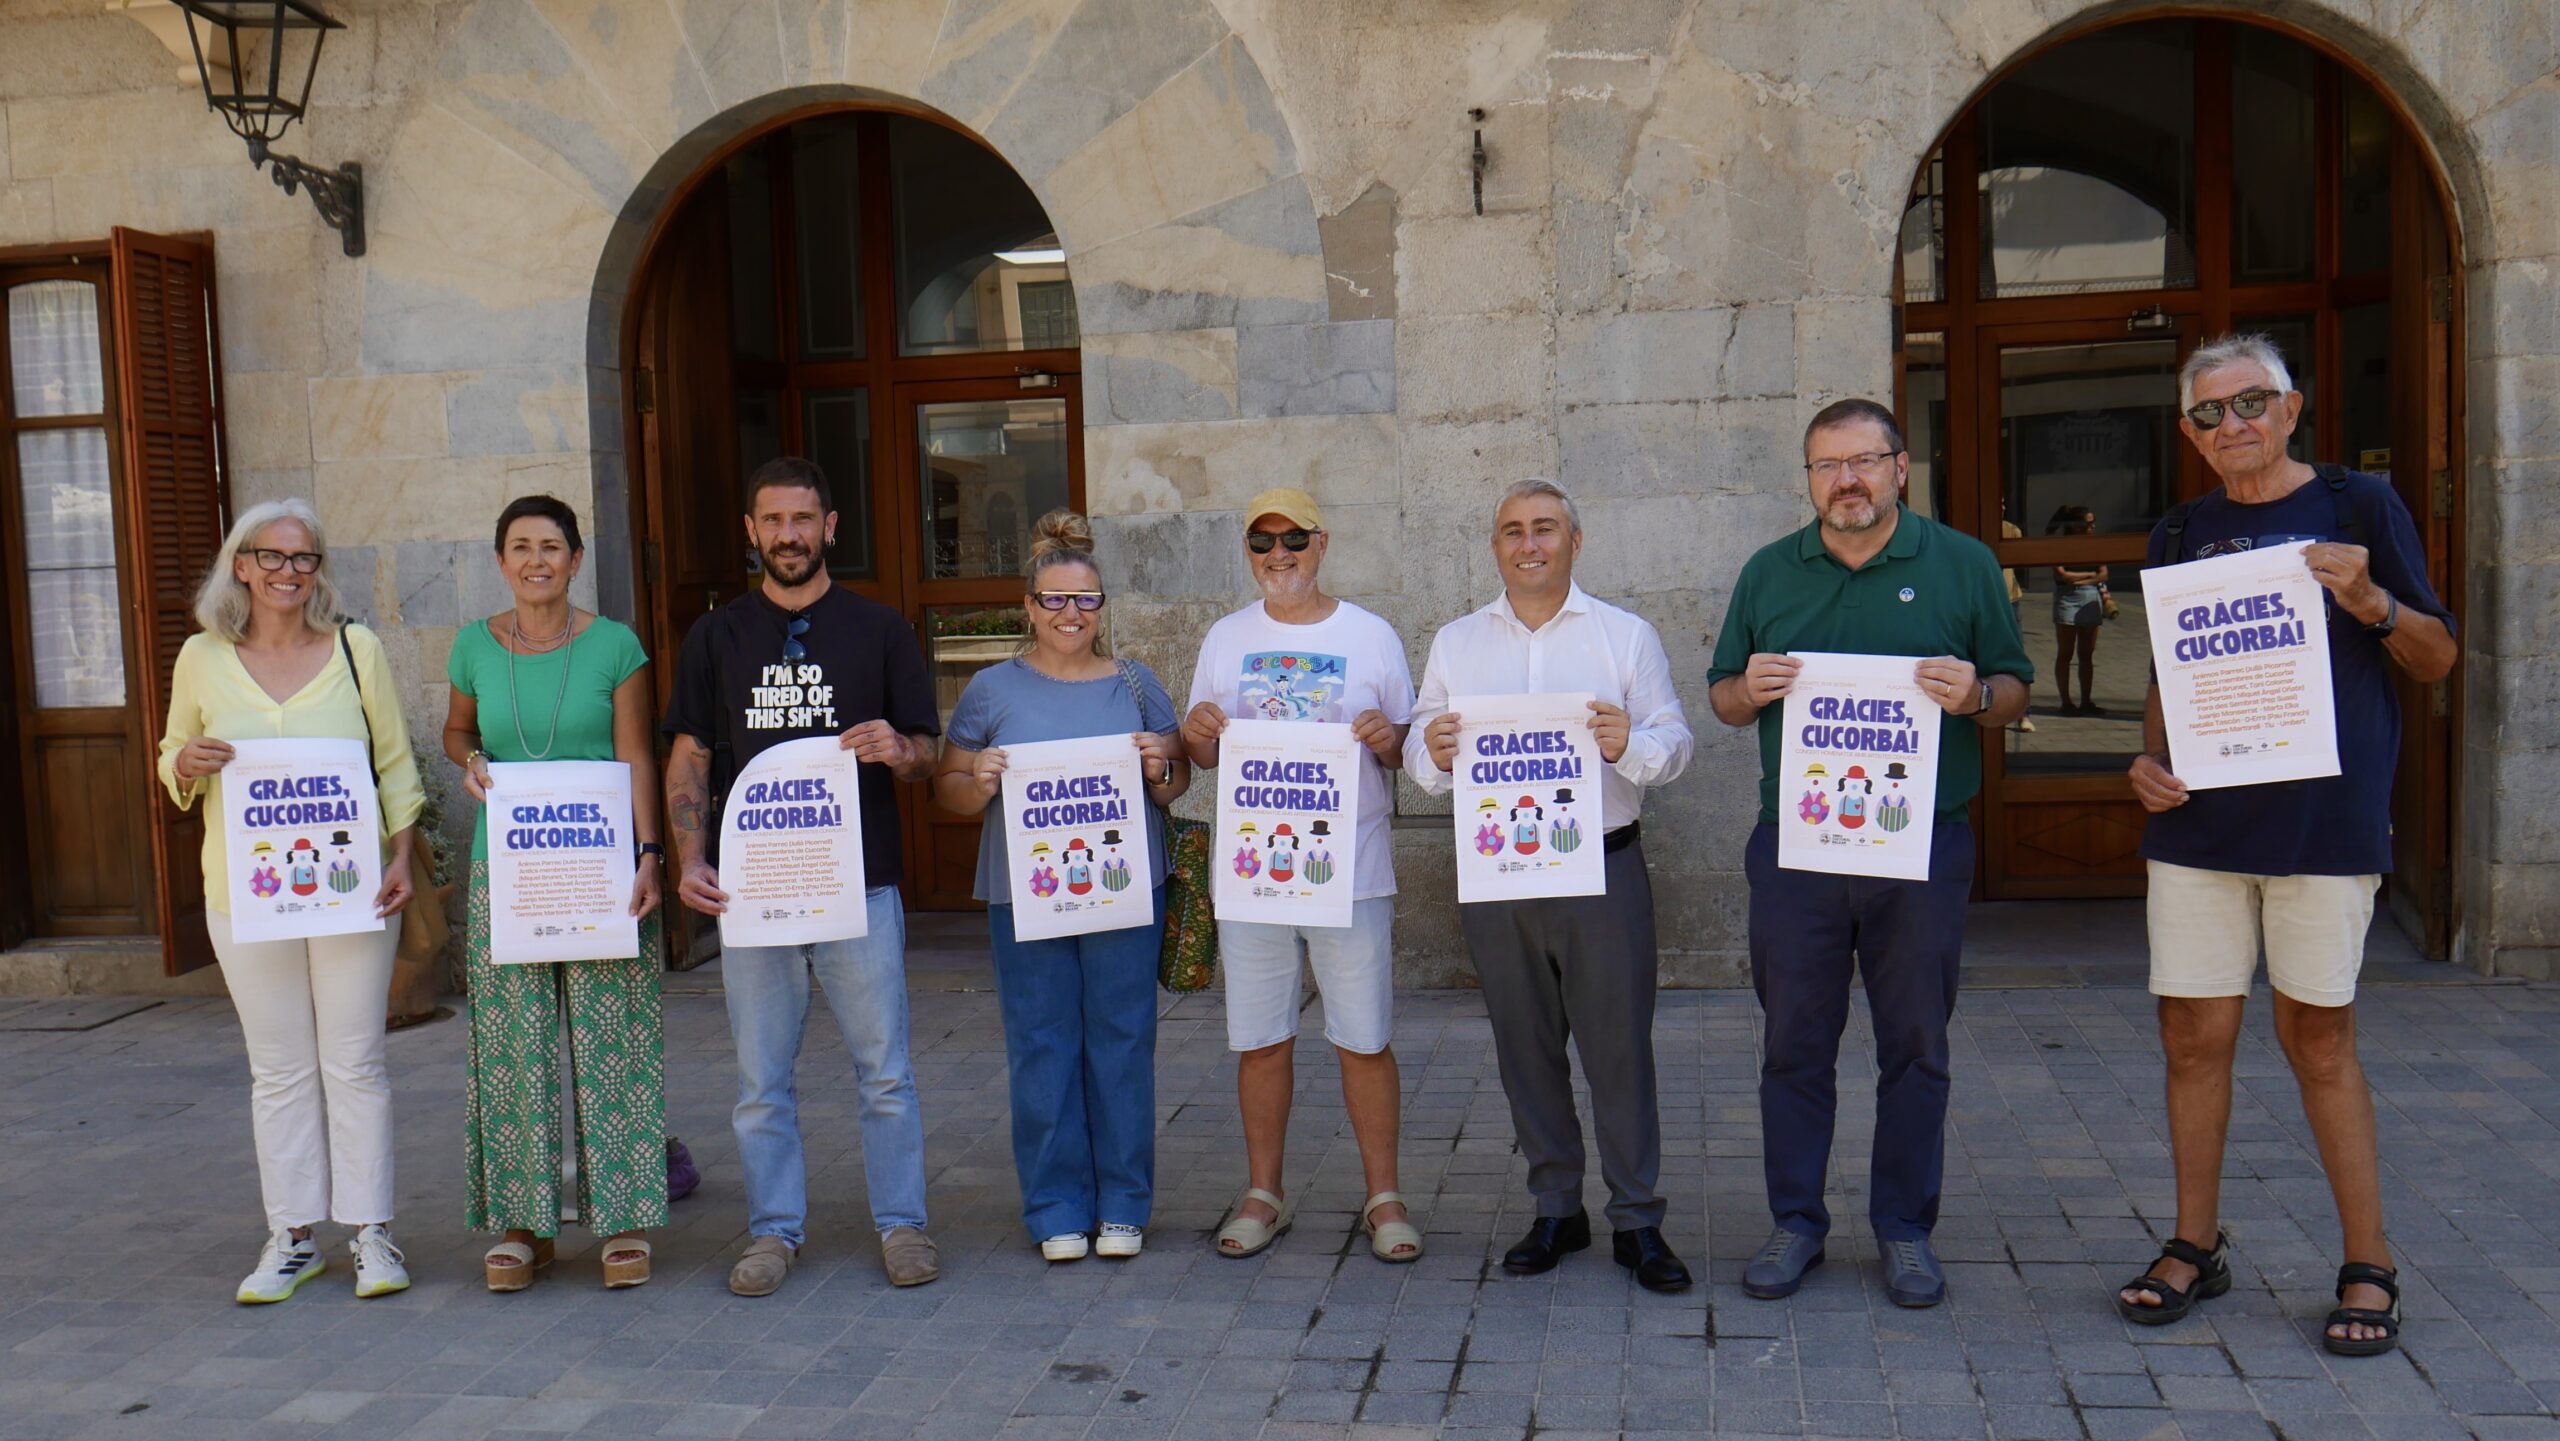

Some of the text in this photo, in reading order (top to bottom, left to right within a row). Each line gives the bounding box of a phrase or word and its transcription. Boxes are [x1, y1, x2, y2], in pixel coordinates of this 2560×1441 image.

[2177, 592, 2295, 632] GRÀCIES,
[2175, 620, 2306, 662] CUCORBA!
[763, 665, 822, 685] I'M SO
[752, 686, 833, 707] TIRED OF
[745, 708, 784, 728] THIS
[1810, 693, 1913, 728] GRÀCIES,
[1476, 729, 1574, 756] GRÀCIES,
[1802, 725, 1918, 753] CUCORBA!
[1241, 757, 1334, 789] GRÀCIES,
[1472, 757, 1582, 784] CUCORBA!
[249, 774, 350, 800] GRÀCIES,
[745, 776, 834, 804] GRÀCIES,
[1026, 775, 1120, 802] GRÀCIES,
[1235, 786, 1339, 812] CUCORBA!
[244, 800, 358, 827] CUCORBA!
[512, 801, 608, 826] GRÀCIES,
[737, 805, 842, 831] CUCORBA!
[1023, 799, 1127, 828] CUCORBA!
[507, 829, 615, 849] CUCORBA!
